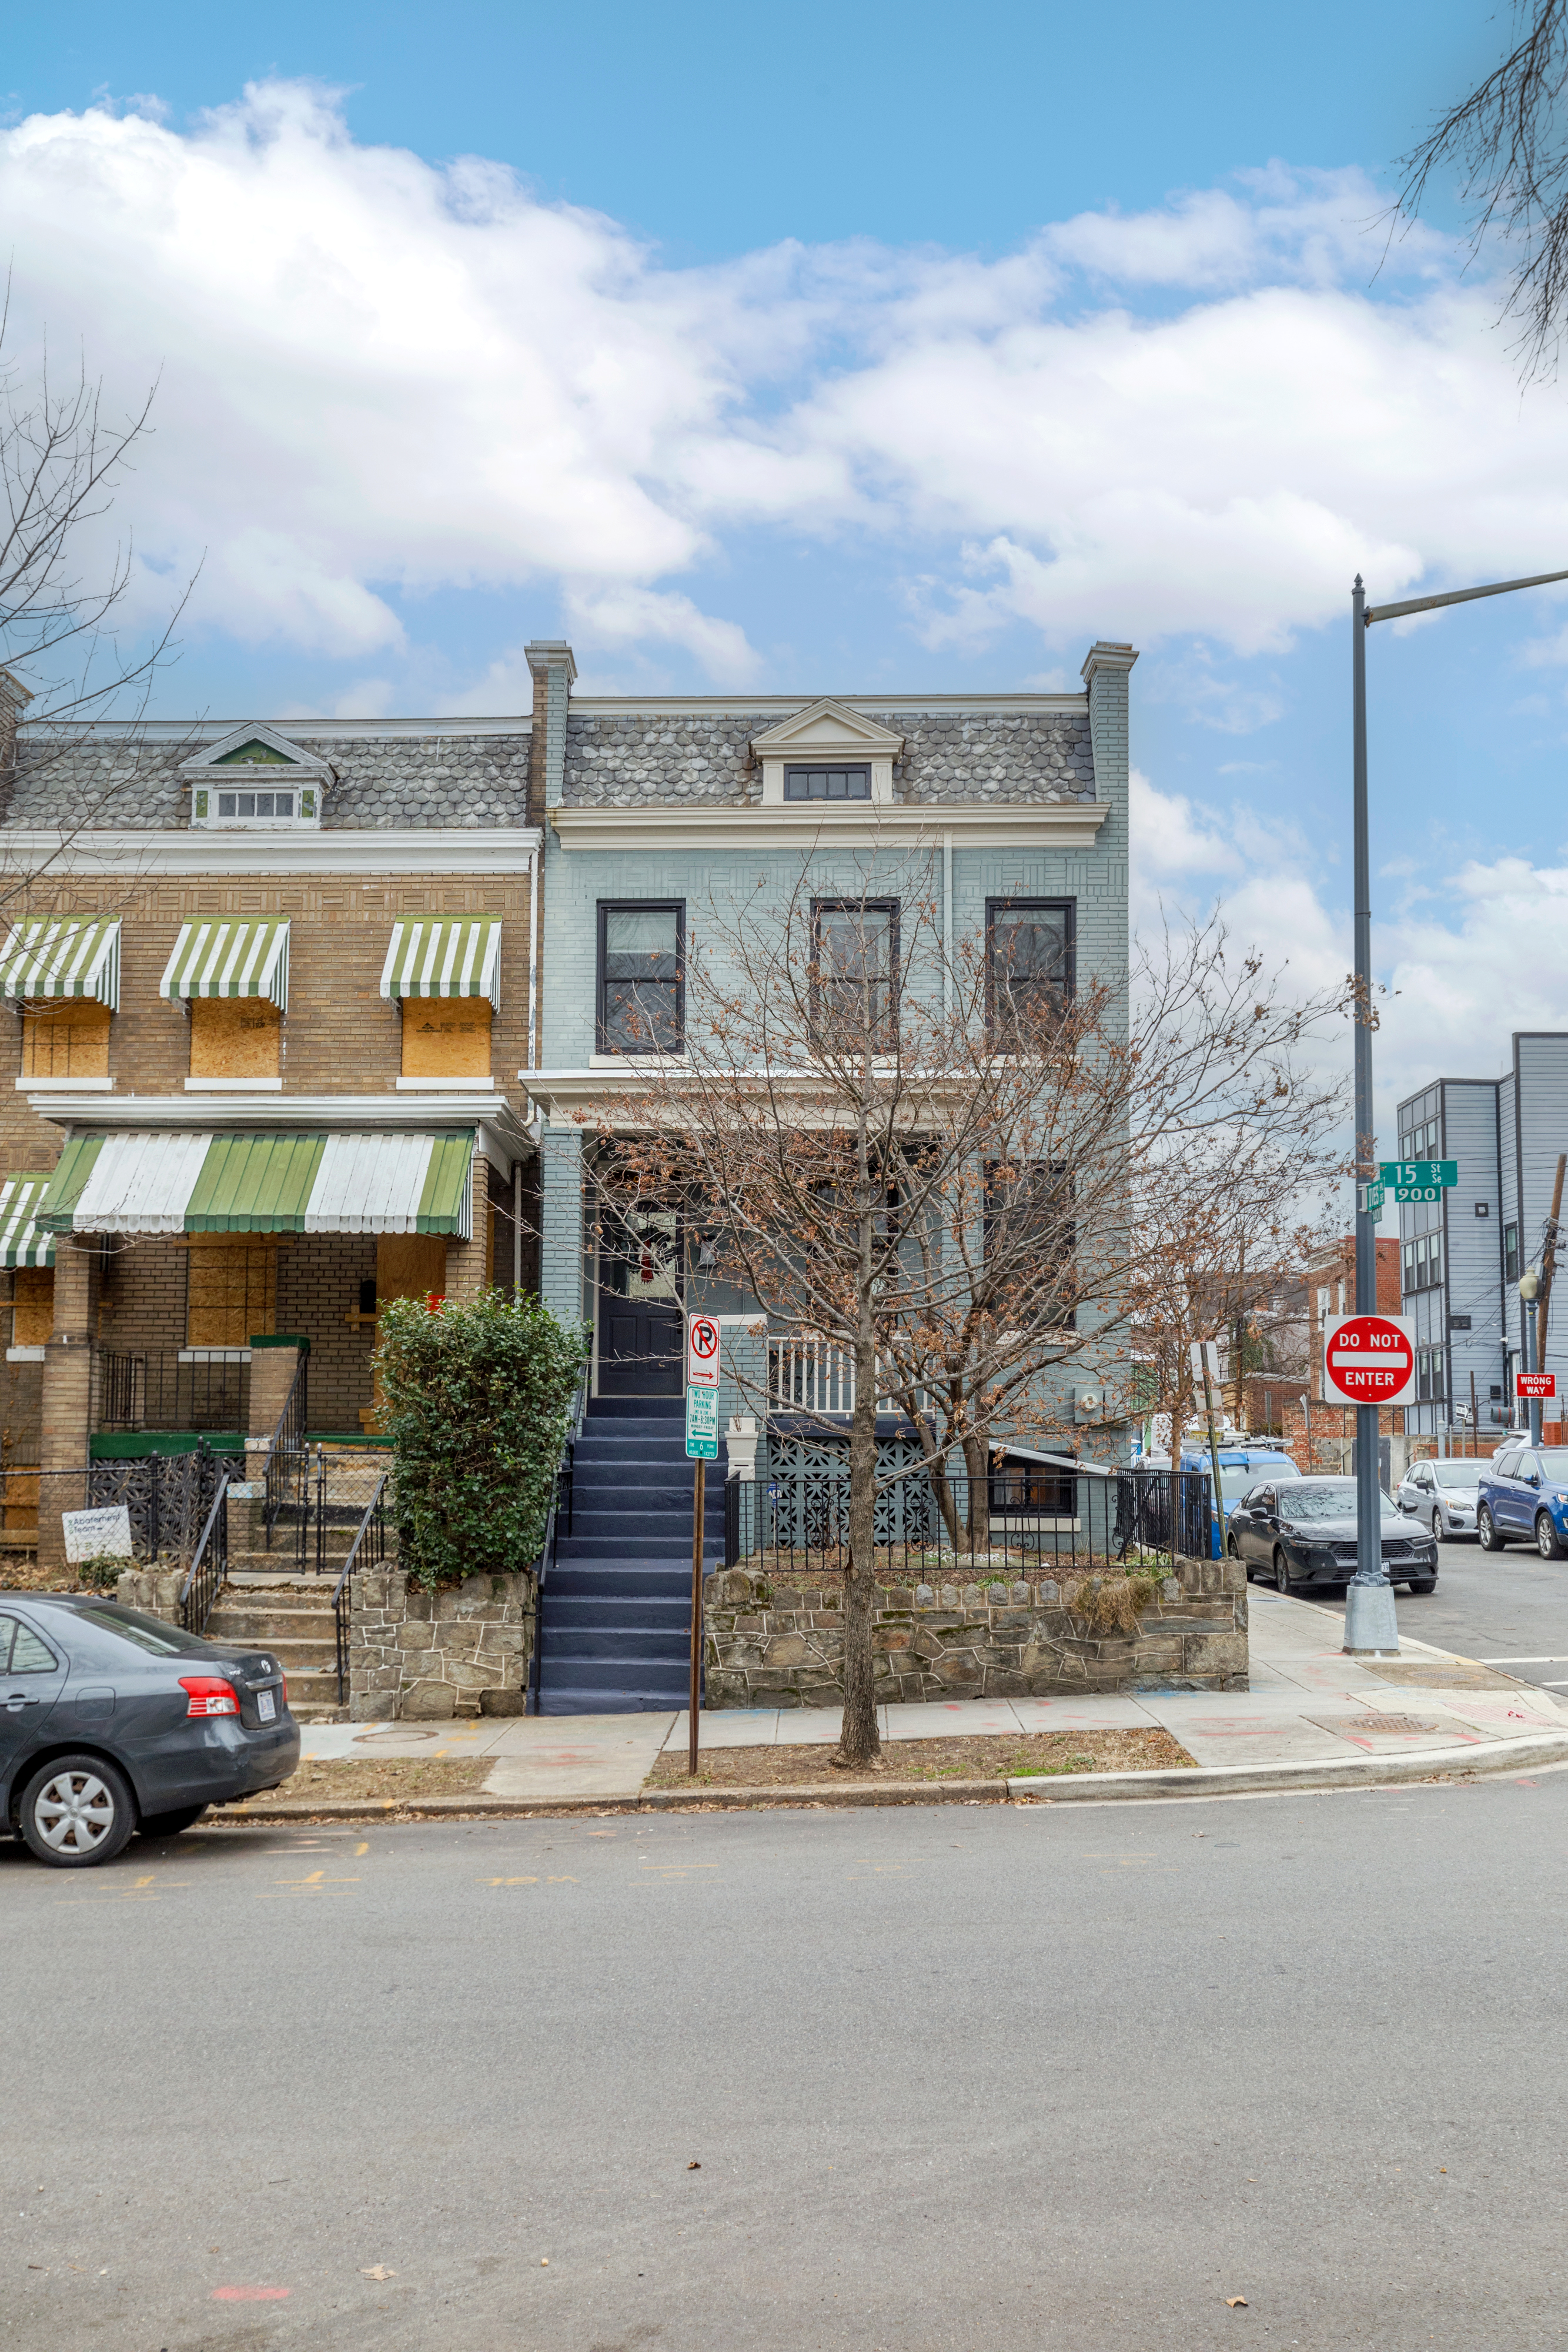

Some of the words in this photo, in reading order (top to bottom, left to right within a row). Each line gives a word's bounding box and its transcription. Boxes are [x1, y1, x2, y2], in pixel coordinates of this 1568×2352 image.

[1395, 1165, 1416, 1184] 15
[1431, 1164, 1440, 1173] St
[1432, 1174, 1442, 1183] Se
[1369, 1185, 1379, 1207] IVES
[1398, 1188, 1436, 1201] 900
[1340, 1334, 1359, 1347] DO
[1370, 1334, 1400, 1347] NOT
[1346, 1372, 1394, 1385] ENTER
[1520, 1377, 1552, 1385] WRONG
[692, 1389, 700, 1398] TWO
[703, 1391, 714, 1400] HOUR
[1526, 1386, 1546, 1394] WAY
[694, 1399, 711, 1409] PARKING
[690, 1414, 716, 1425] 7AM-8:30PM
[700, 1442, 703, 1450] 6
[73, 1514, 120, 1525] Abatement
